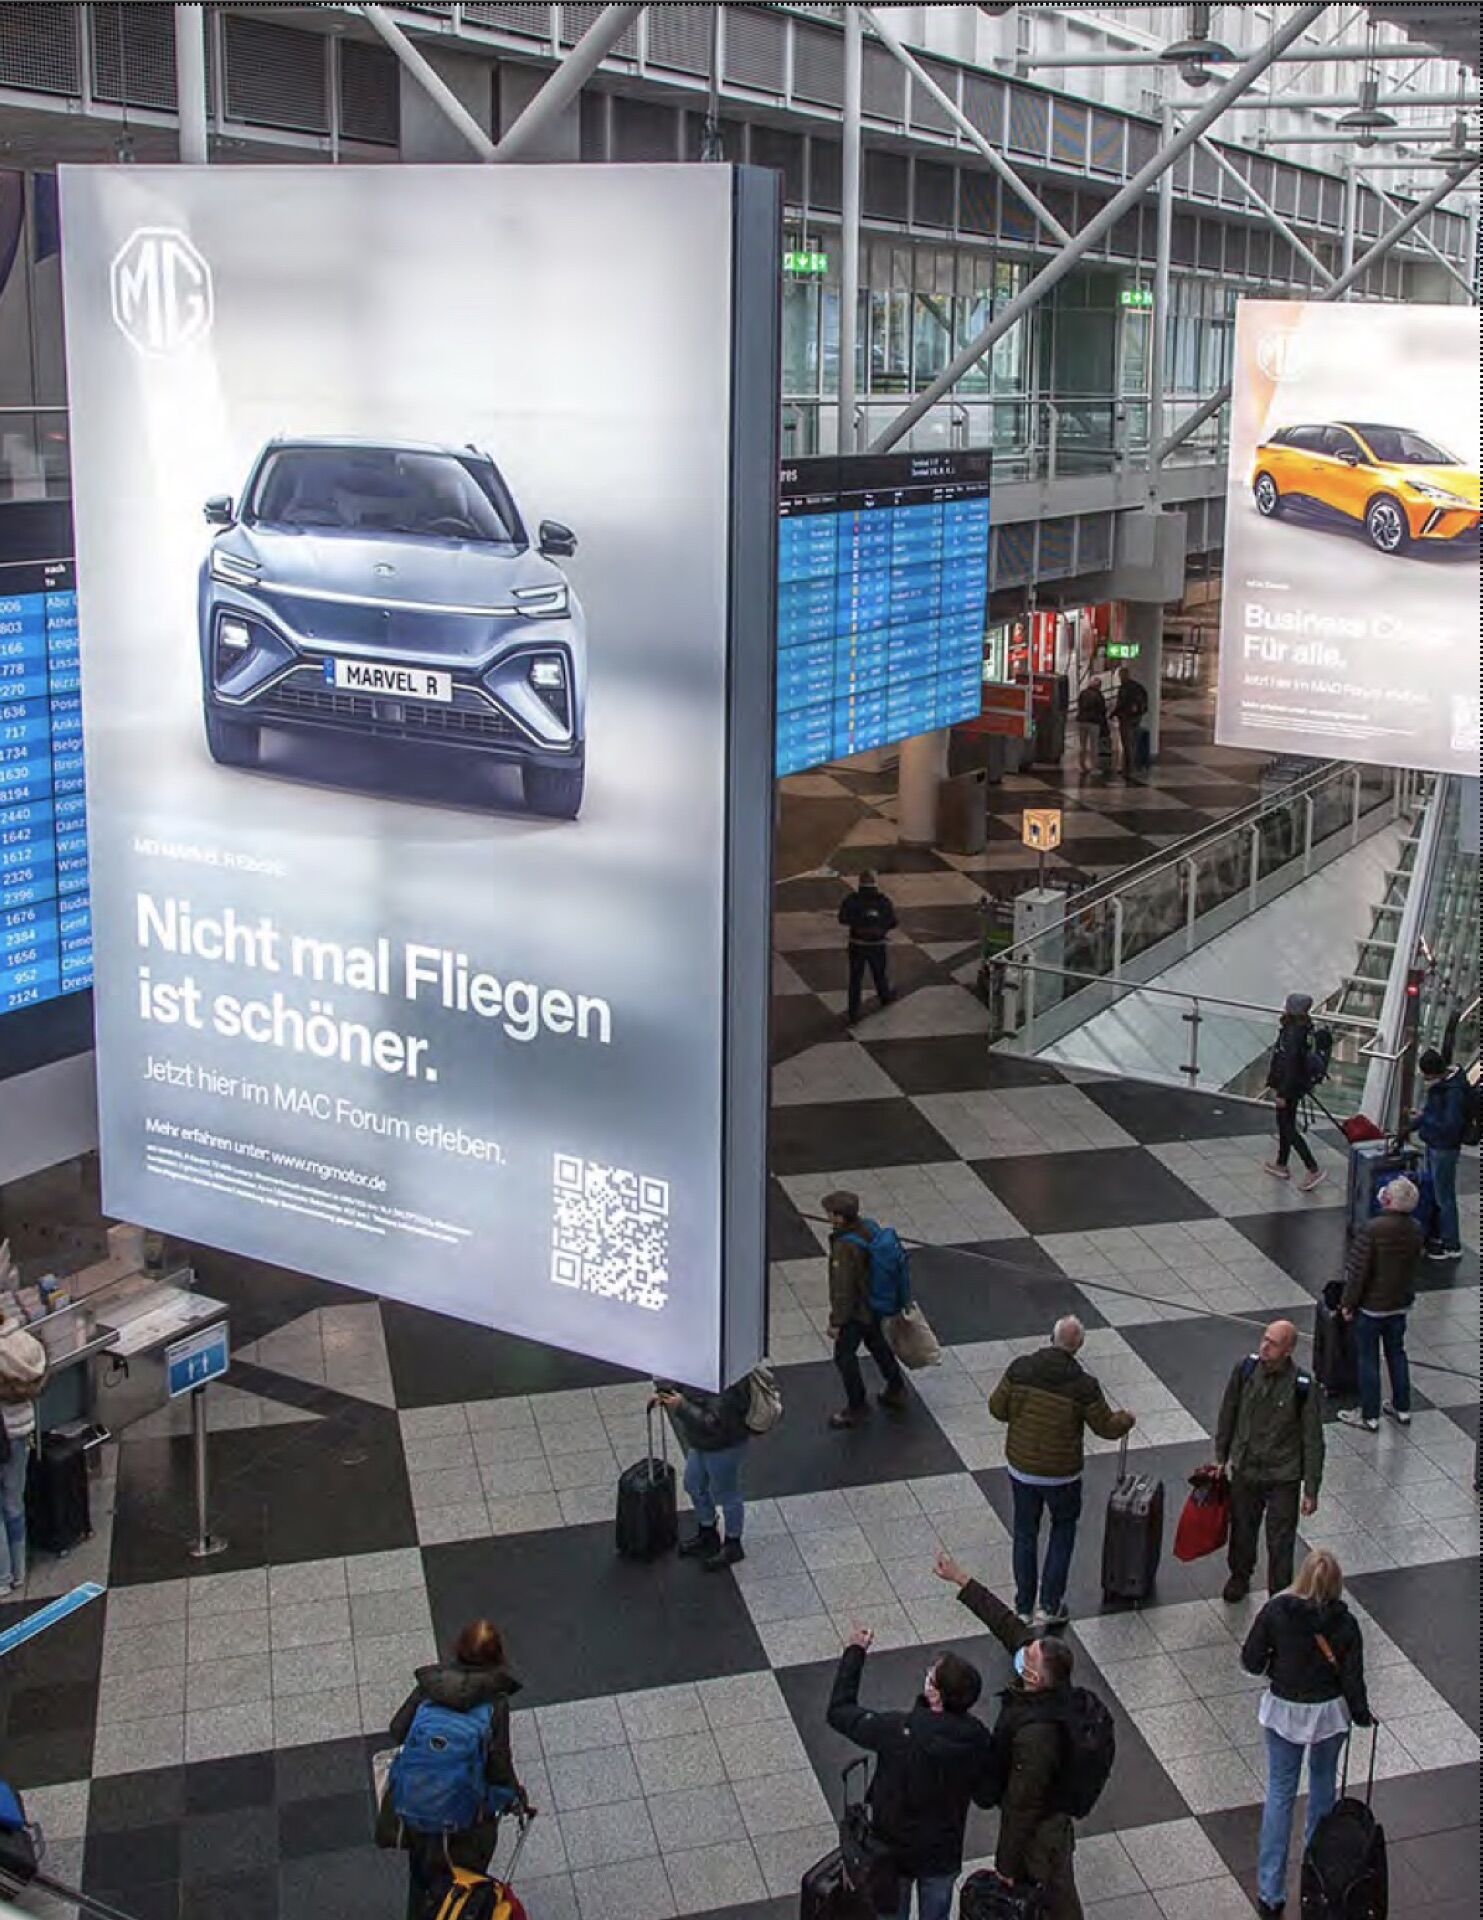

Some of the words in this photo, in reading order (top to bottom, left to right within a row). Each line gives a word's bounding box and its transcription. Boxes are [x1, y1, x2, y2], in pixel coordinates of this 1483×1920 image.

[119, 238, 206, 348] MG
[346, 664, 418, 692] MARVEL
[426, 675, 438, 695] R
[1244, 634, 1286, 662] Für
[137, 892, 281, 972] Nicht
[291, 937, 390, 995] mal
[405, 943, 612, 1043] Fliegen
[139, 967, 202, 1029] ist
[212, 992, 439, 1082] schöner.
[144, 1056, 195, 1089] Jetzt
[198, 1066, 239, 1097] hier
[241, 1077, 269, 1105] im
[274, 1083, 332, 1120] MAC
[336, 1099, 411, 1141] Forum
[414, 1122, 507, 1166] erleben.
[145, 1117, 179, 1138] Mehr
[181, 1124, 232, 1151] erfahren
[235, 1139, 270, 1162] unter:
[271, 1150, 388, 1192] www.mgmotor.de
